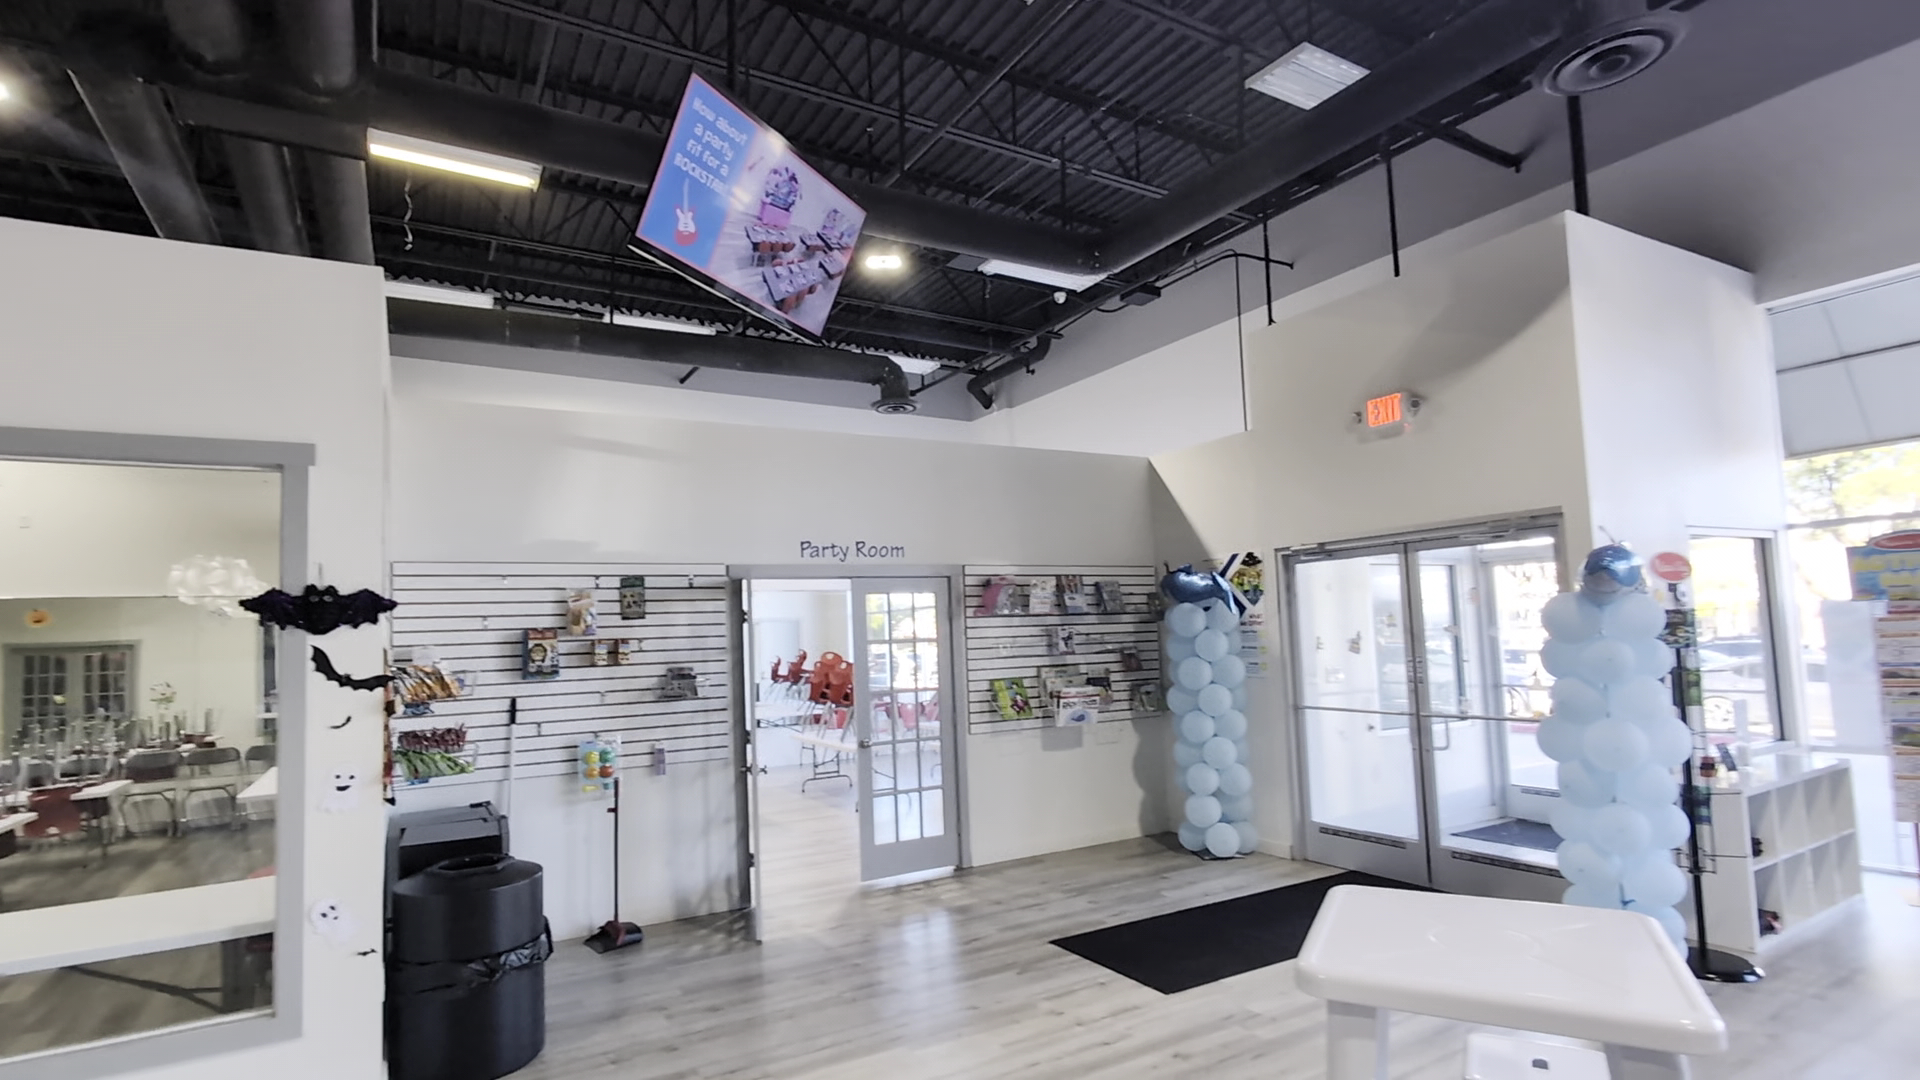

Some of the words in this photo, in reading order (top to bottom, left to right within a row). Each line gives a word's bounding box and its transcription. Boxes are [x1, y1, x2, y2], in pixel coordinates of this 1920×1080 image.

[693, 122, 704, 136] a
[702, 130, 734, 161] party
[715, 116, 748, 146] about
[719, 163, 729, 177] a
[1368, 395, 1400, 426] EXIT
[800, 540, 849, 562] Party
[855, 540, 905, 558] Room
